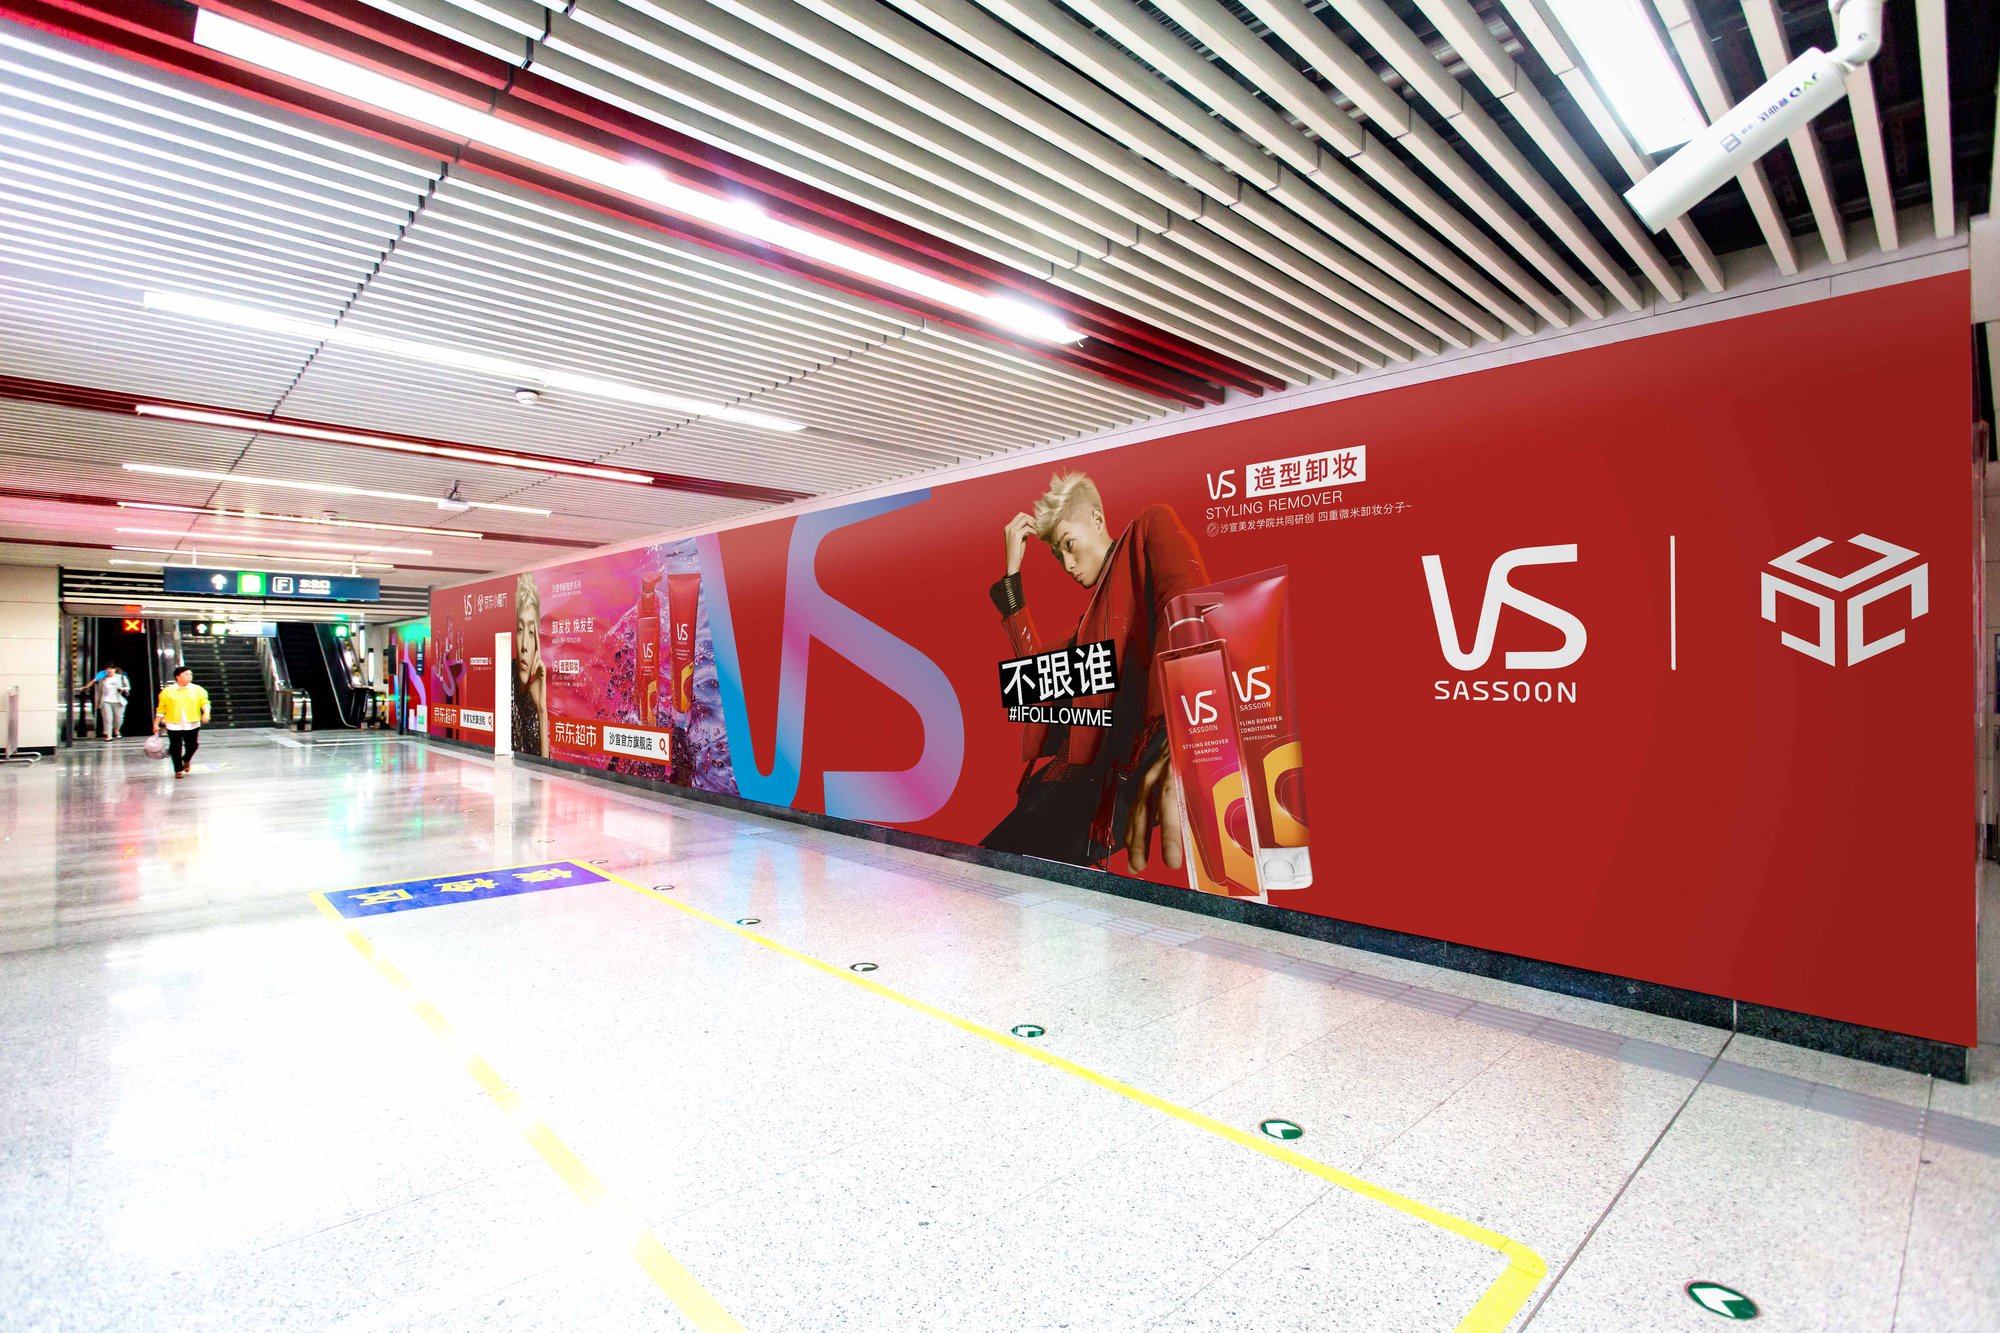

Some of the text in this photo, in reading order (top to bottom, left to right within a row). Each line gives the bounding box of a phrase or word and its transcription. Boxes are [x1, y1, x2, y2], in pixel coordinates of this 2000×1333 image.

[1254, 452, 1358, 491] 造型卸妆
[1206, 469, 1237, 500] VS
[1206, 490, 1343, 519] STYLING REMOVER
[1220, 513, 1315, 533] 沙宣美发学院共同研创
[1421, 543, 1587, 671] VS
[1002, 642, 1115, 705] 不跟谁
[1232, 666, 1271, 702] VS
[1434, 680, 1577, 703] SASSOON
[1009, 706, 1113, 727] #IFOLLOWME
[1181, 690, 1218, 726] VS
[1240, 702, 1271, 711] SASSOON
[1188, 725, 1218, 734] SASSOON
[1240, 724, 1278, 733] CONDITIONER
[1256, 716, 1283, 724] REMOVER
[555, 722, 597, 747] 京东超市
[609, 732, 652, 751] 沙宣官方旗舰店
[1182, 742, 1204, 750] STYLING
[1194, 747, 1219, 755] SHAMPOO
